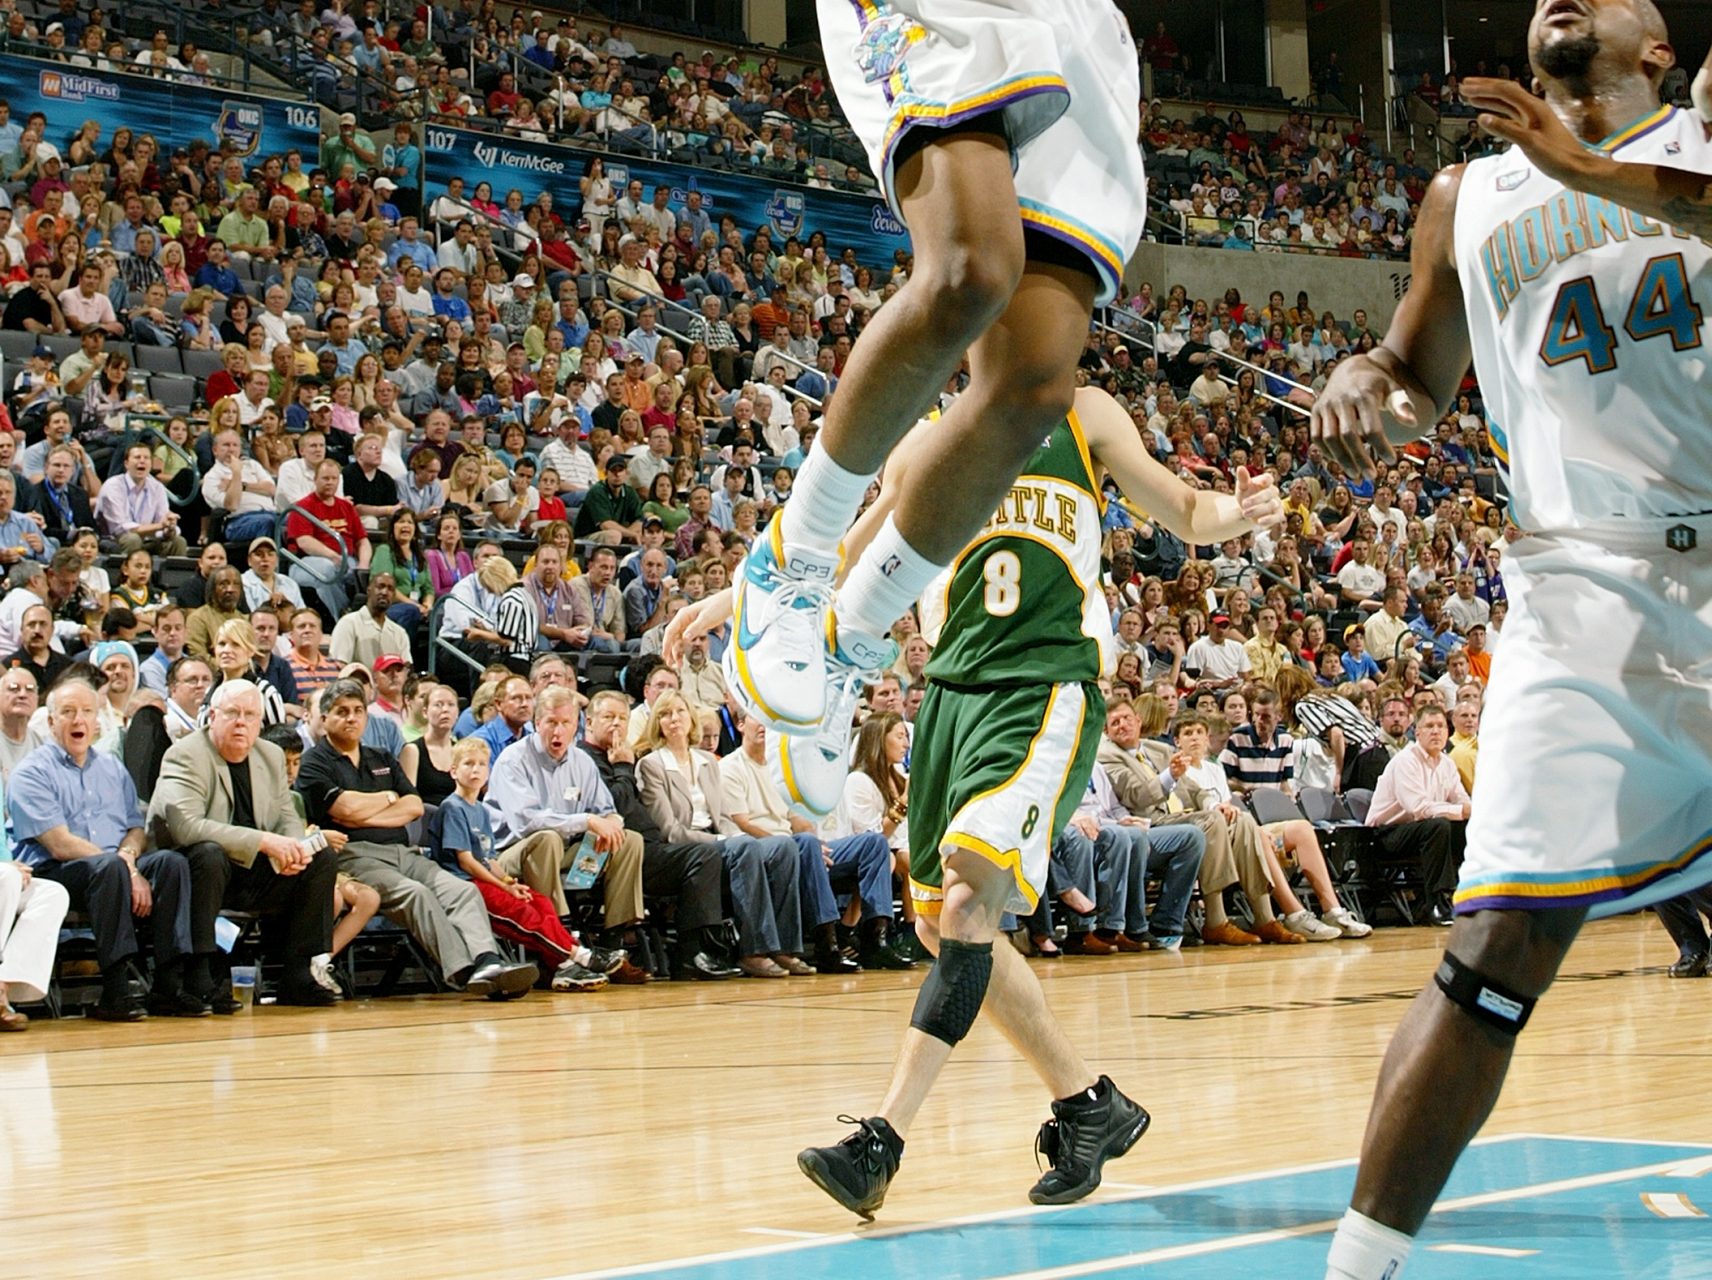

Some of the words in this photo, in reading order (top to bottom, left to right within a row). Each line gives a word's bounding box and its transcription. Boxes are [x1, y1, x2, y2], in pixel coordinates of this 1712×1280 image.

[62, 76, 117, 97] MidFirst
[285, 106, 317, 129] 106
[427, 130, 457, 151] 107
[501, 151, 565, 174] KerrMcGee
[1538, 252, 1704, 375] 44
[790, 558, 830, 579] CP3
[983, 549, 1021, 618] 8
[1021, 804, 1040, 840] 8
